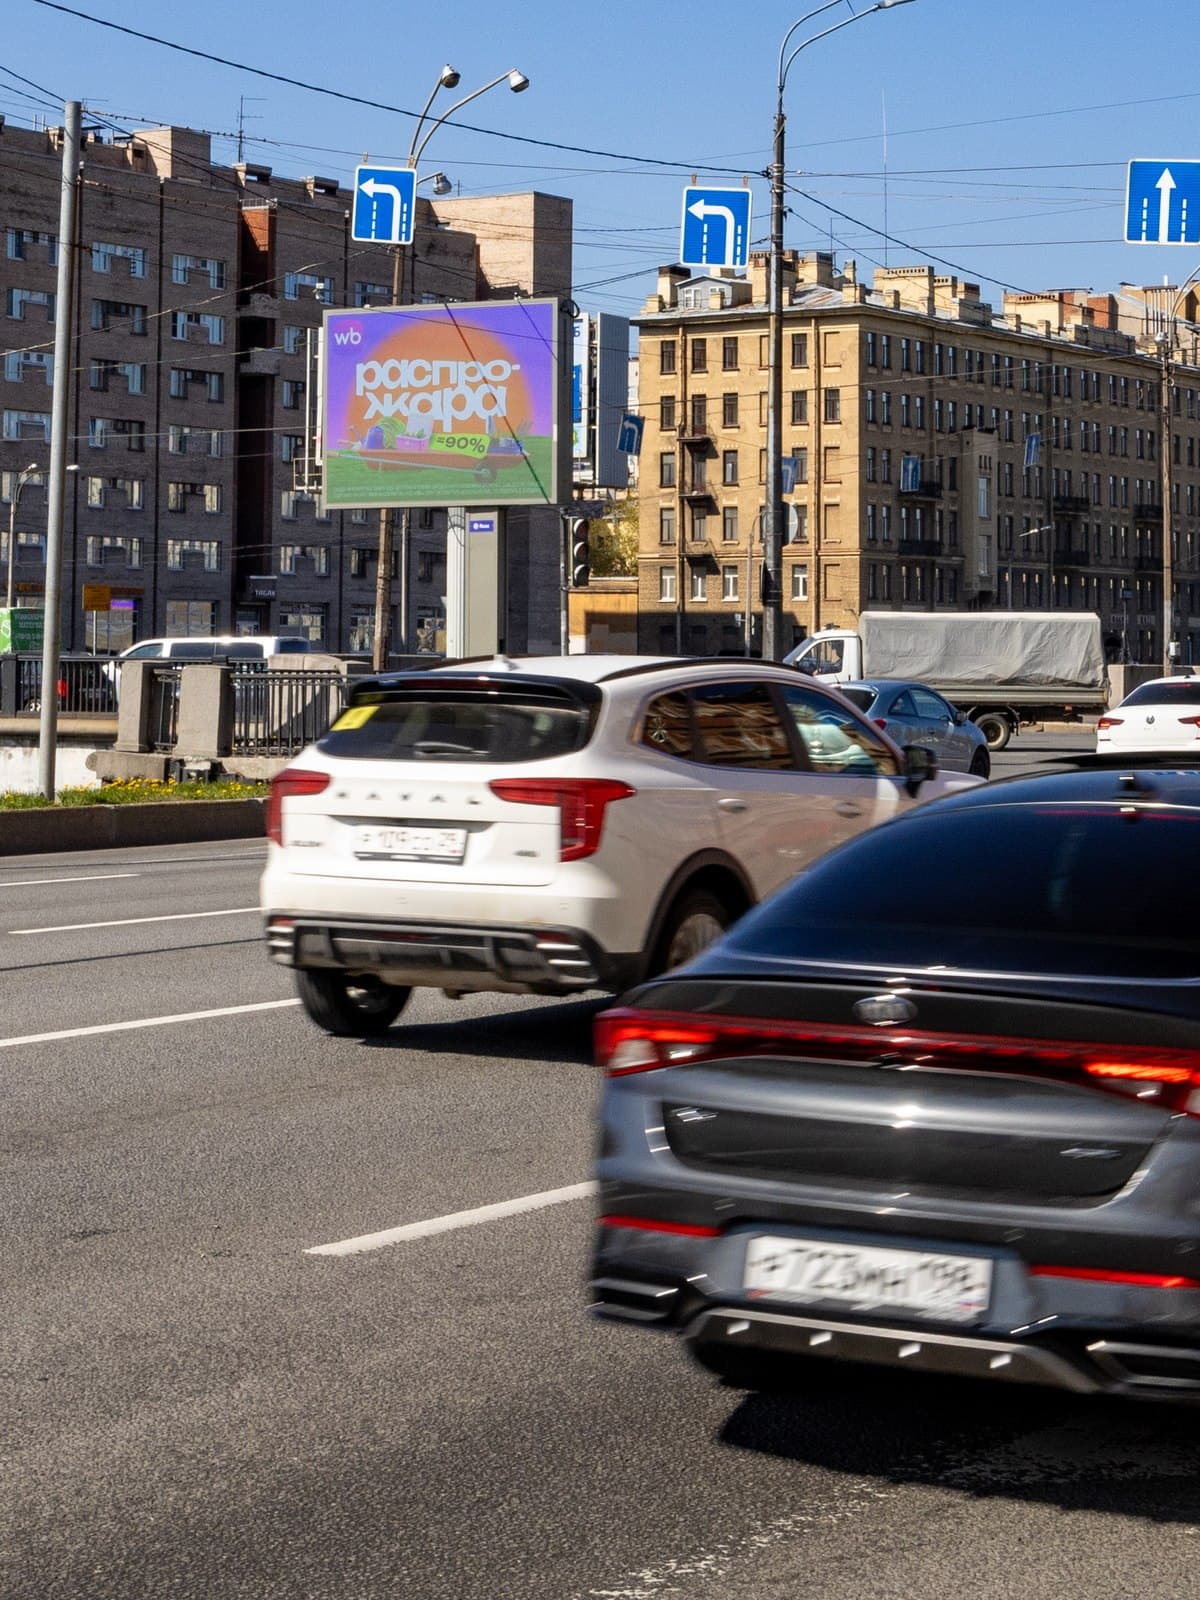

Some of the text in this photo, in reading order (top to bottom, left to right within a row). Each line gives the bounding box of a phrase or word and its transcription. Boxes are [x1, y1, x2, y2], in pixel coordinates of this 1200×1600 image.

[335, 328, 362, 345] wb
[356, 359, 521, 395] распро-
[363, 384, 507, 433] жара
